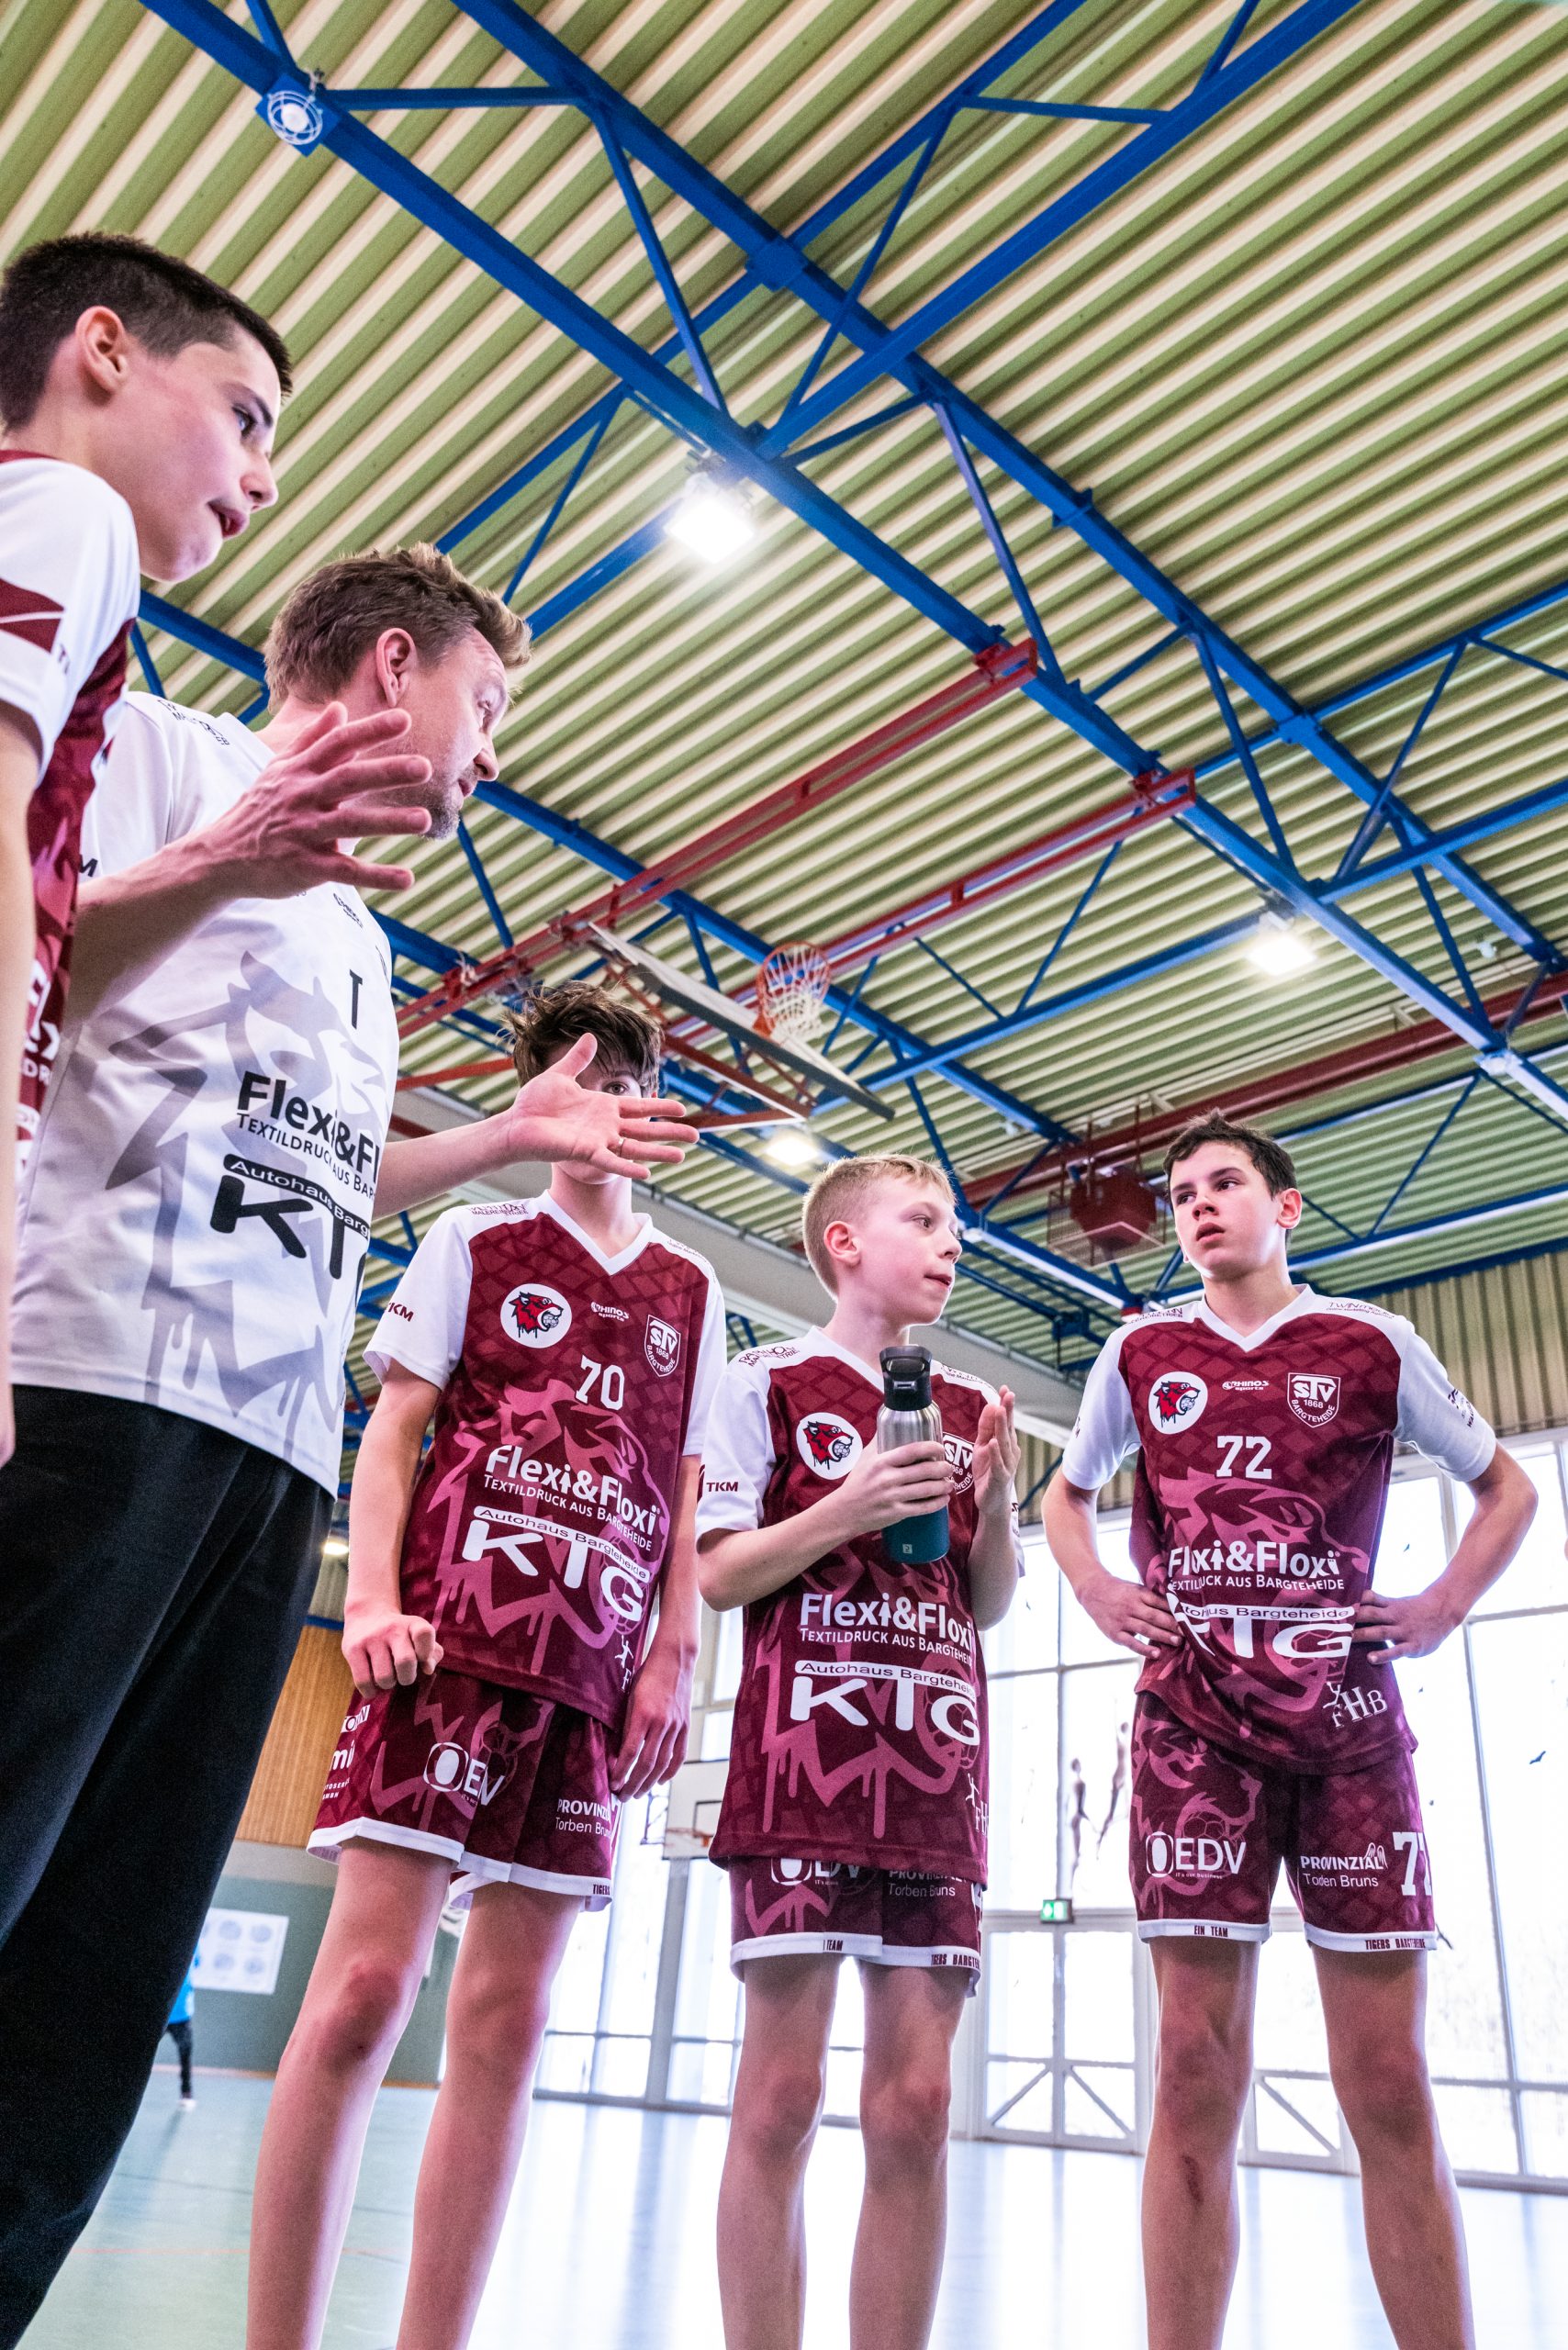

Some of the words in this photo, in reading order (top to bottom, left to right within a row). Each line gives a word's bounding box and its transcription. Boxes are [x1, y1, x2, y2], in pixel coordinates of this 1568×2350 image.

[350, 968, 363, 1030] T
[237, 1070, 380, 1184] Flexi&Fl
[230, 1160, 334, 1211] Autohaus
[210, 1174, 367, 1307] KT
[388, 1302, 414, 1322] KM
[575, 1354, 625, 1411] 70
[1291, 1375, 1337, 1403] STV
[1291, 1399, 1336, 1423] BARGTEHEIDE
[1304, 1399, 1324, 1409] 1868
[1215, 1435, 1272, 1480] 72
[485, 1444, 657, 1537] Flexi&Floxi
[706, 1481, 739, 1493] TKM
[484, 1474, 566, 1509] TEXTILDRUCK
[569, 1501, 593, 1517] AUS
[597, 1506, 653, 1551] BARGTEHEIDE
[479, 1508, 568, 1538] Autohaus
[575, 1532, 646, 1579] Bargteheide
[462, 1519, 644, 1622] KTG
[1169, 1539, 1340, 1579] Flxi&Floxi
[1226, 1577, 1252, 1588] AUS
[1256, 1574, 1345, 1591] BARGTEHEIDE
[1237, 1607, 1349, 1620] Bargteheide
[801, 1628, 889, 1645] TEXTILDRUCK
[892, 1633, 915, 1649] AUS
[801, 1662, 893, 1677] Autohaus
[790, 1676, 980, 1746] KTG
[555, 1817, 592, 1833] Torben
[889, 1882, 926, 1897] Torben
[1340, 1874, 1379, 1887] Bruns
[1193, 1925, 1205, 1935] EIN
[1210, 1926, 1228, 1938] TEAM
[1365, 1938, 1391, 1951] TIGERS
